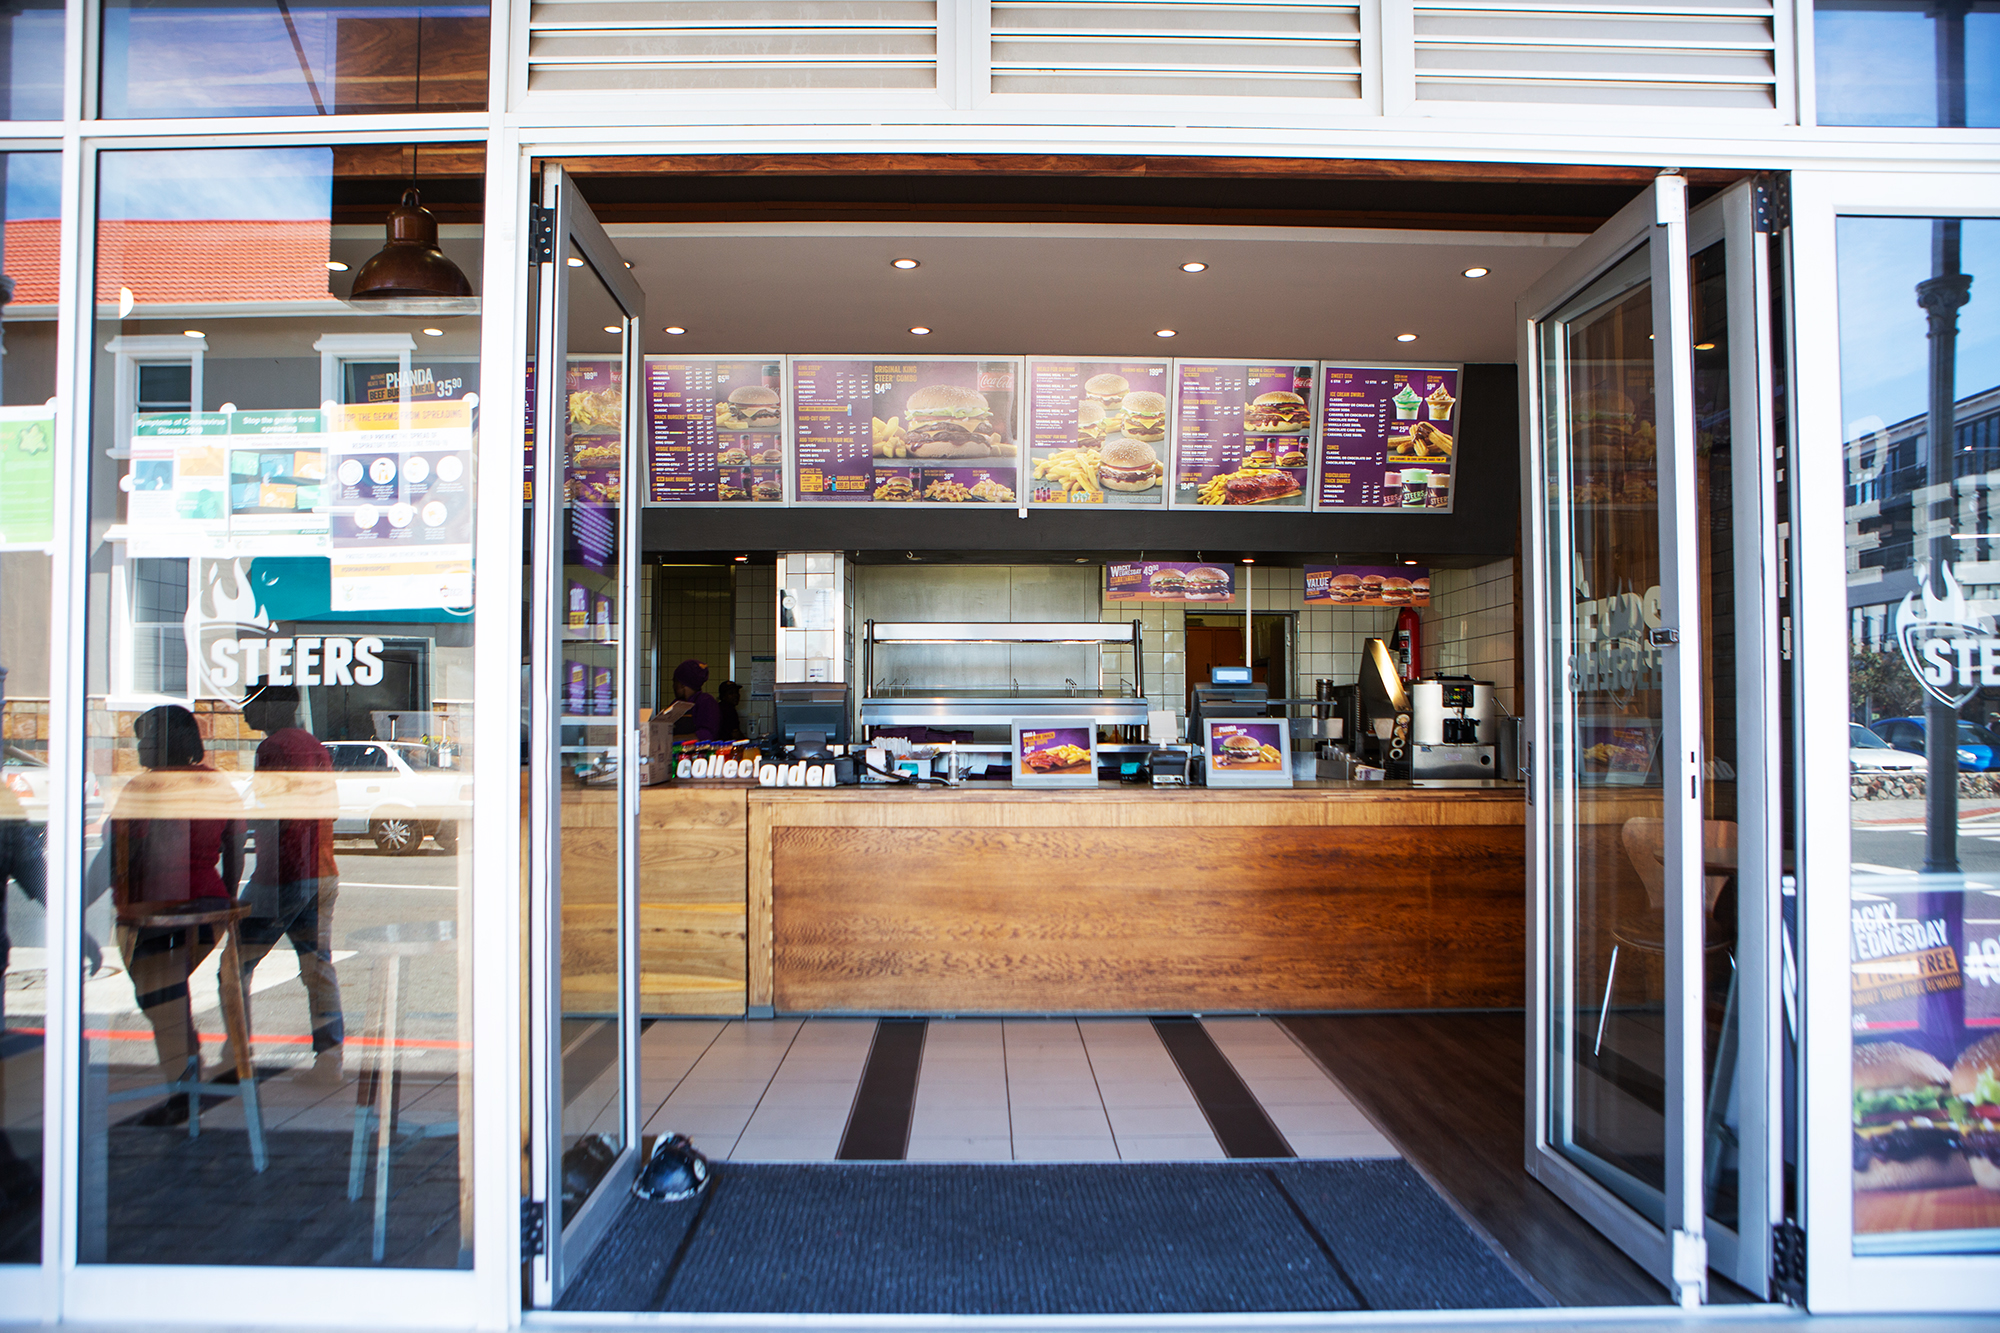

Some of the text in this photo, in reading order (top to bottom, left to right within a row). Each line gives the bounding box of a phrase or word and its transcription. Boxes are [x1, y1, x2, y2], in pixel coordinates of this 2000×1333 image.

[386, 368, 434, 390] PHANDA
[369, 390, 386, 400] BEEF
[414, 383, 434, 394] MEAL
[137, 418, 173, 428] Symptoms
[182, 418, 226, 426] Coronavirus
[243, 416, 261, 425] Stop
[274, 418, 297, 426] germs
[358, 412, 372, 422] THE
[422, 409, 462, 420] SPREADING
[260, 424, 298, 433] spreading
[1404, 490, 1425, 500] STEERS
[1306, 577, 1330, 588] VALUE
[210, 637, 384, 688] STEERS
[676, 754, 762, 778] collect
[759, 760, 836, 787] order
[1852, 902, 1898, 934] ACKY
[1852, 918, 1948, 961] EDNESDAY
[1918, 950, 1955, 974] FREE
